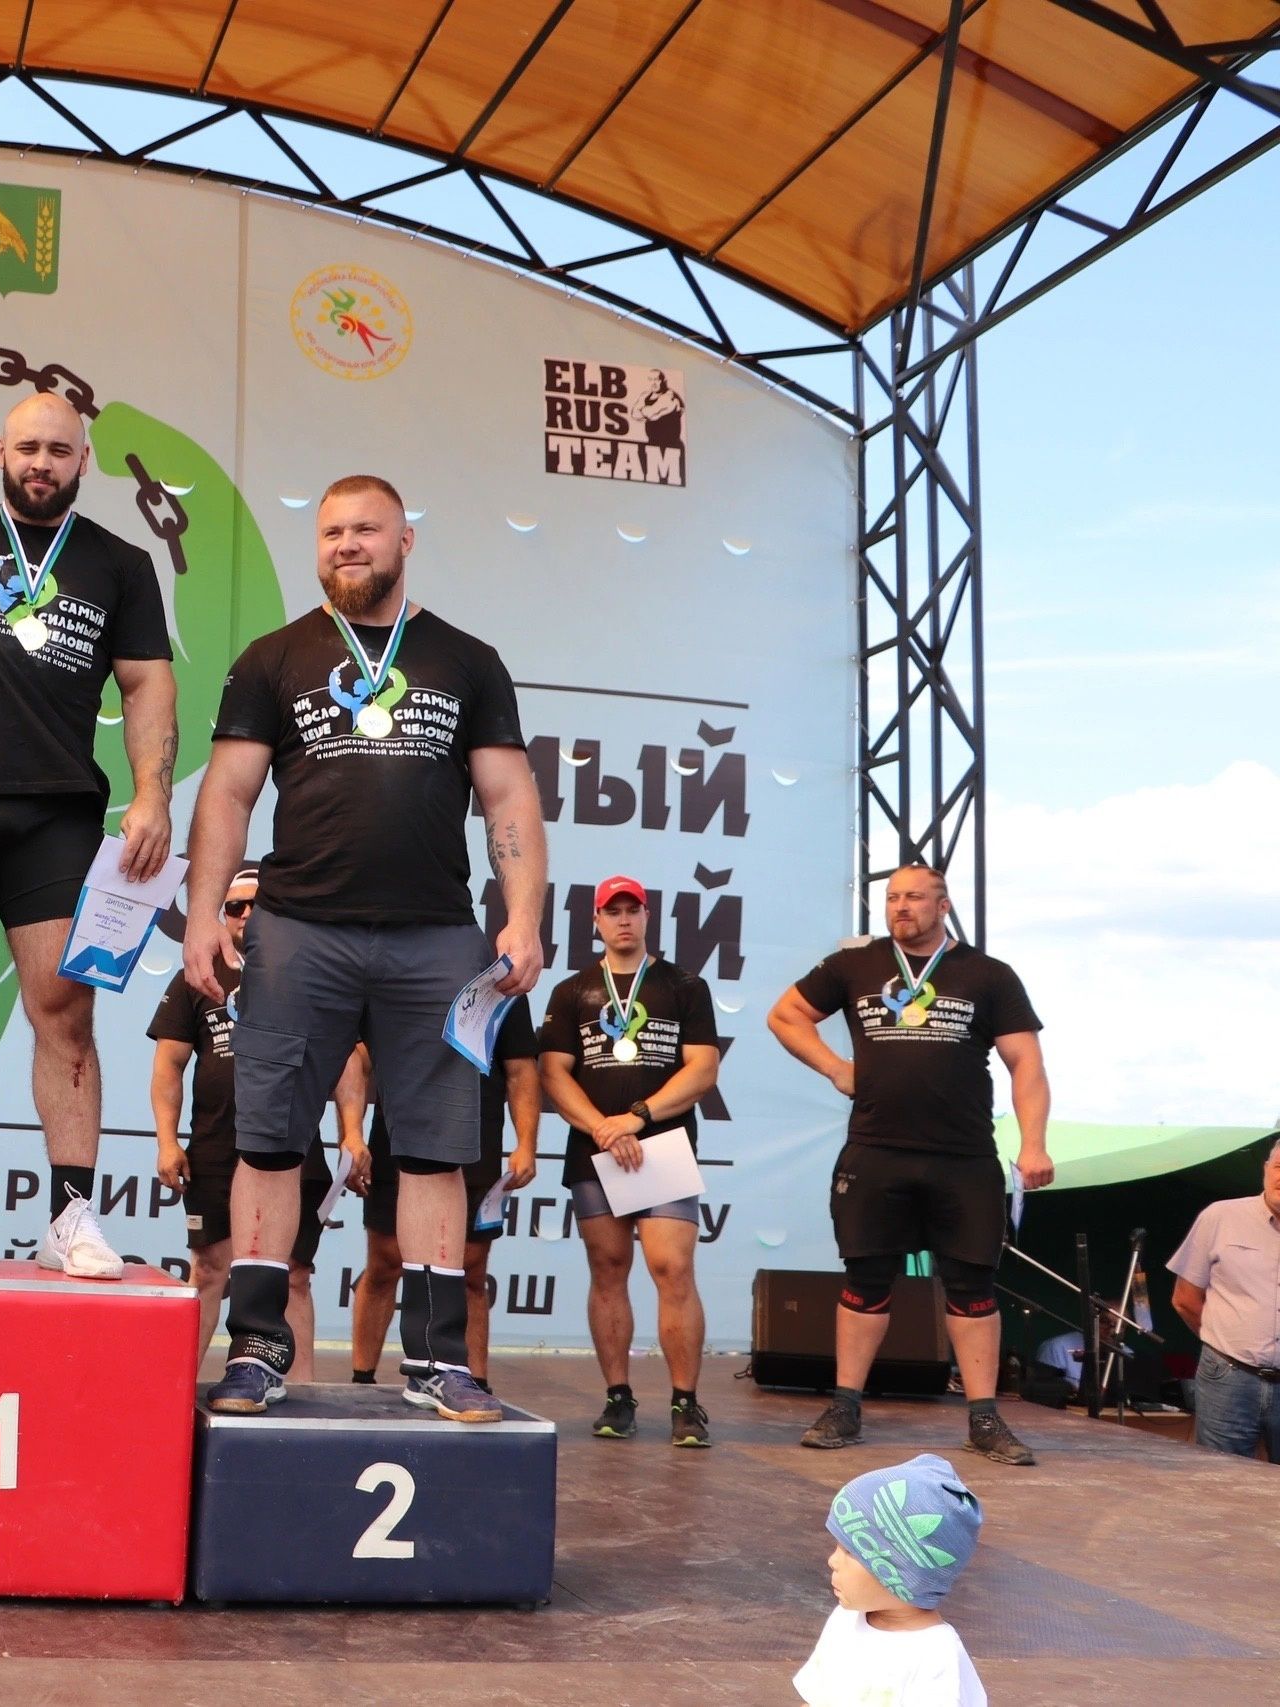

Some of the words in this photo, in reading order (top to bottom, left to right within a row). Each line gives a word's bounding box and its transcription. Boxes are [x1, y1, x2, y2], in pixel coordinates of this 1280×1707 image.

[544, 359, 627, 399] ELB
[545, 395, 630, 436] RUS
[548, 434, 682, 486] TEAM
[38, 613, 101, 640] СИЛЬНЫЙ
[59, 600, 106, 627] САМЫЙ
[27, 650, 51, 663] ОРЬБЕ
[393, 709, 458, 730] СИЛЬНЫЙ
[411, 693, 460, 715] САМЫЙ
[352, 1462, 416, 1559] 2
[832, 1487, 914, 1602] didas
